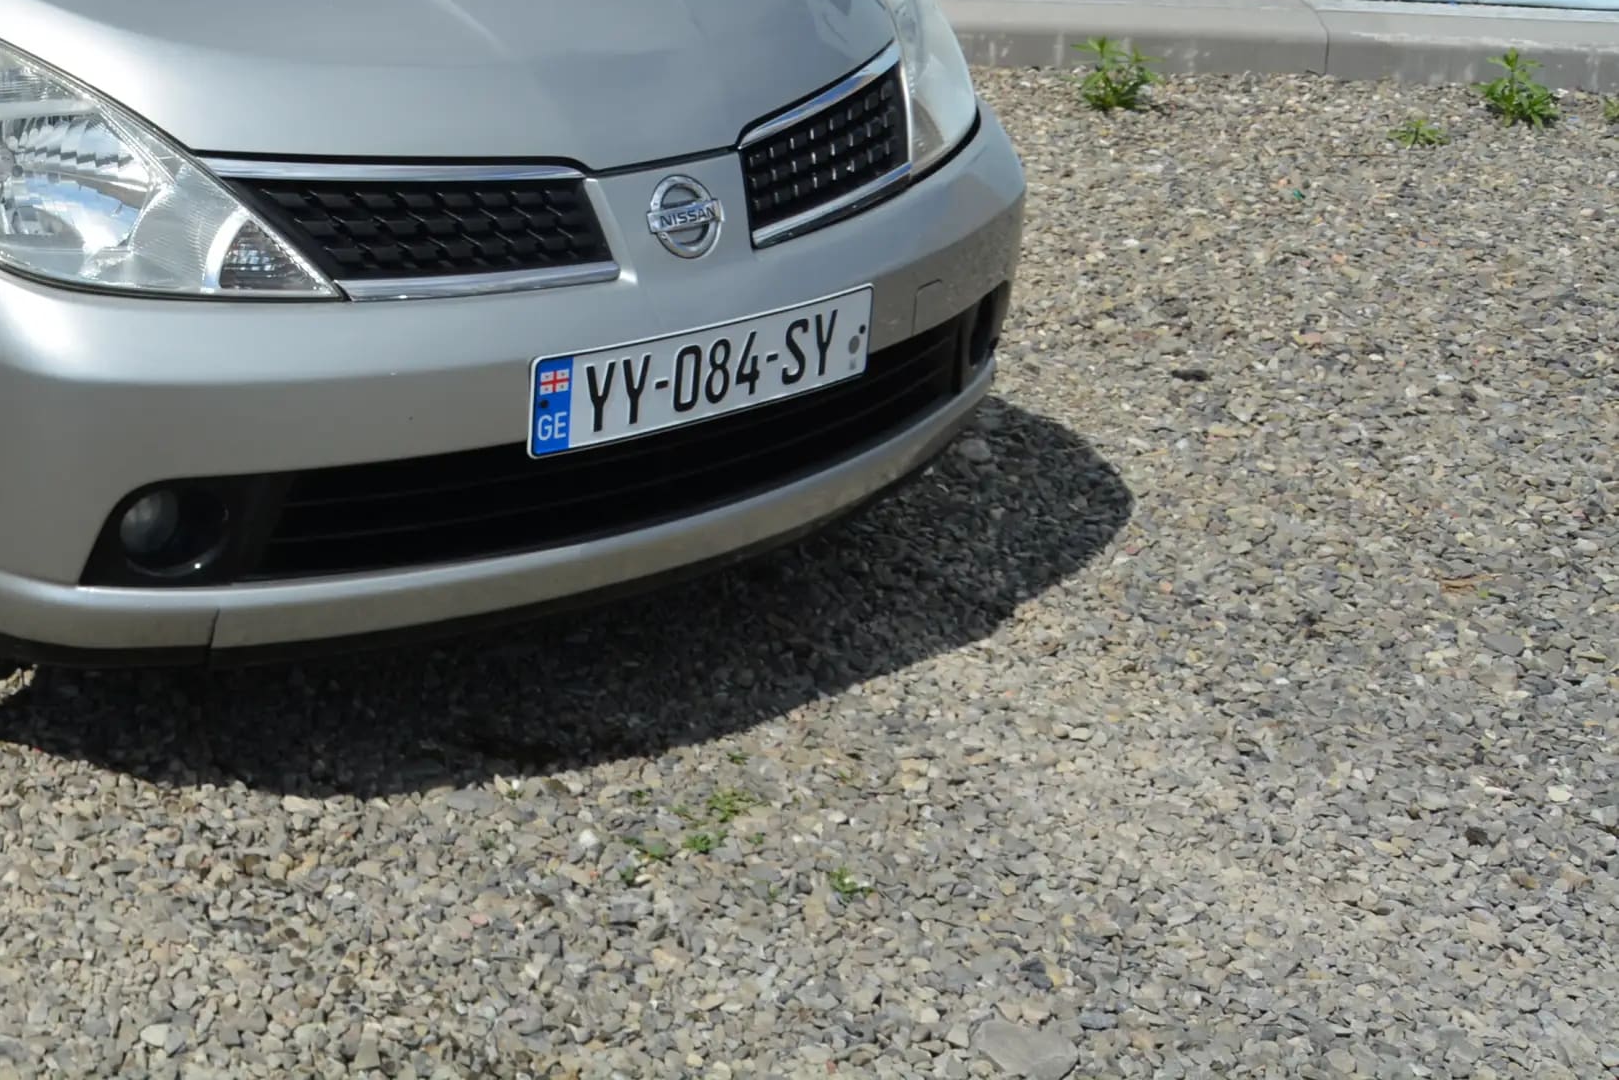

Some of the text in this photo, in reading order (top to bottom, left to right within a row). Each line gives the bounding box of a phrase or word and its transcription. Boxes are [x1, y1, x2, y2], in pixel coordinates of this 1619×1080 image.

[660, 207, 716, 227] NISSAN
[586, 309, 838, 432] YY-084-SY
[537, 411, 567, 442] GE
